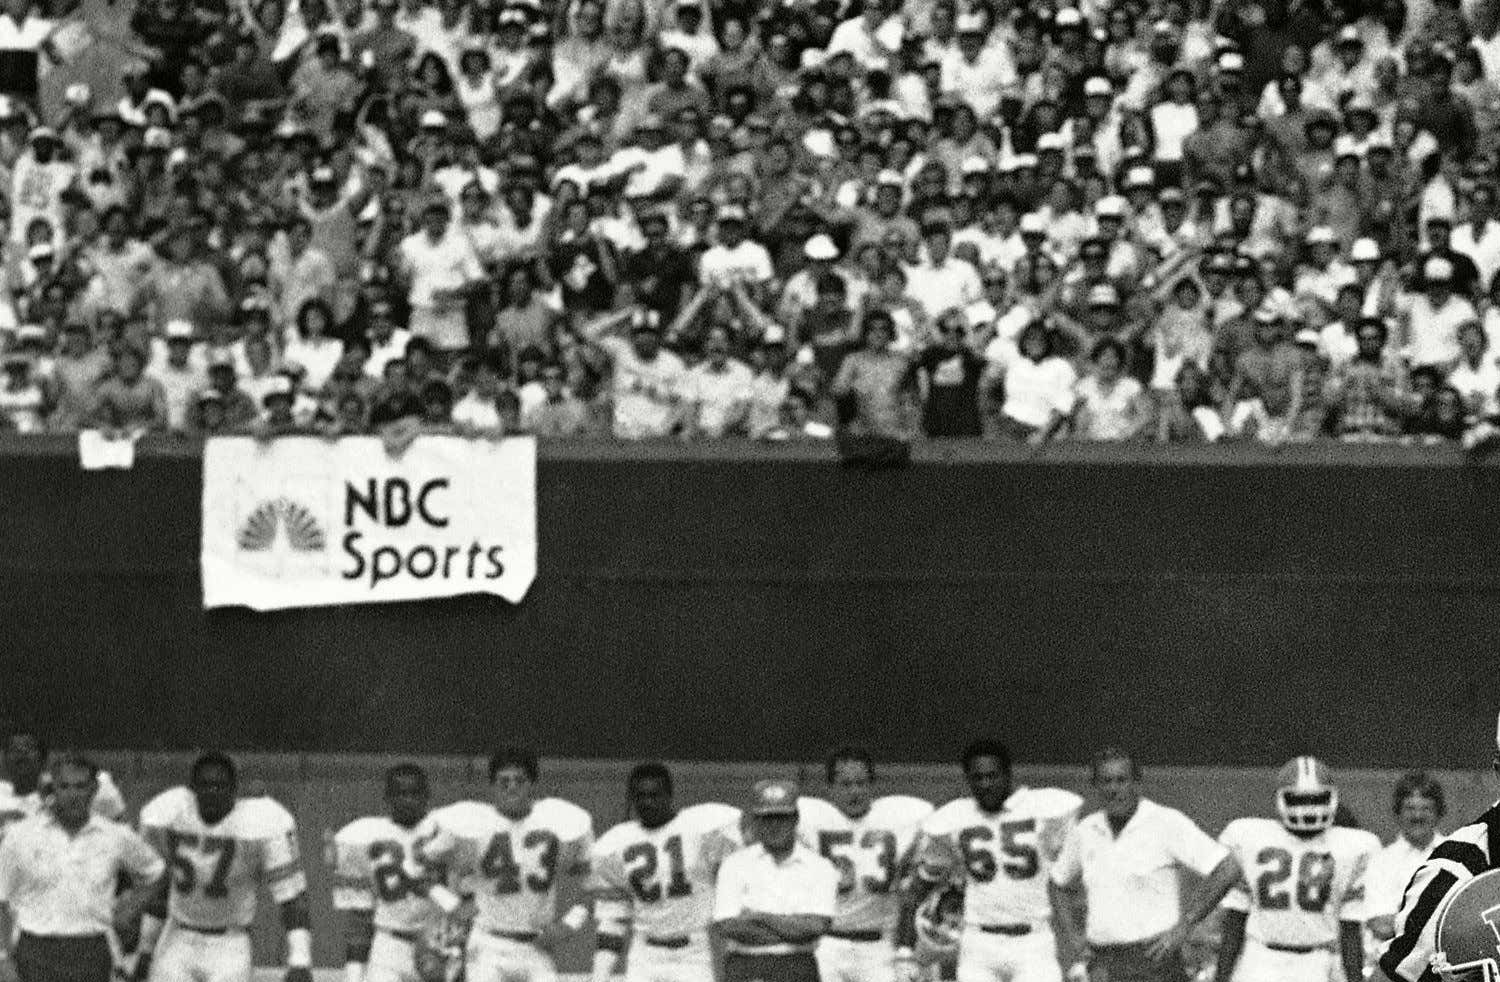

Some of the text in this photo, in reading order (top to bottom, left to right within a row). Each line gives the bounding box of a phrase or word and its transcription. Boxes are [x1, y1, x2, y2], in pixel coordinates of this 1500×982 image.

[344, 477, 449, 527] NBC
[342, 530, 505, 590] Sports
[166, 829, 235, 898] 57
[481, 830, 559, 894] 43
[622, 835, 693, 902] 21
[818, 829, 896, 894] 53
[958, 818, 1039, 883] 65
